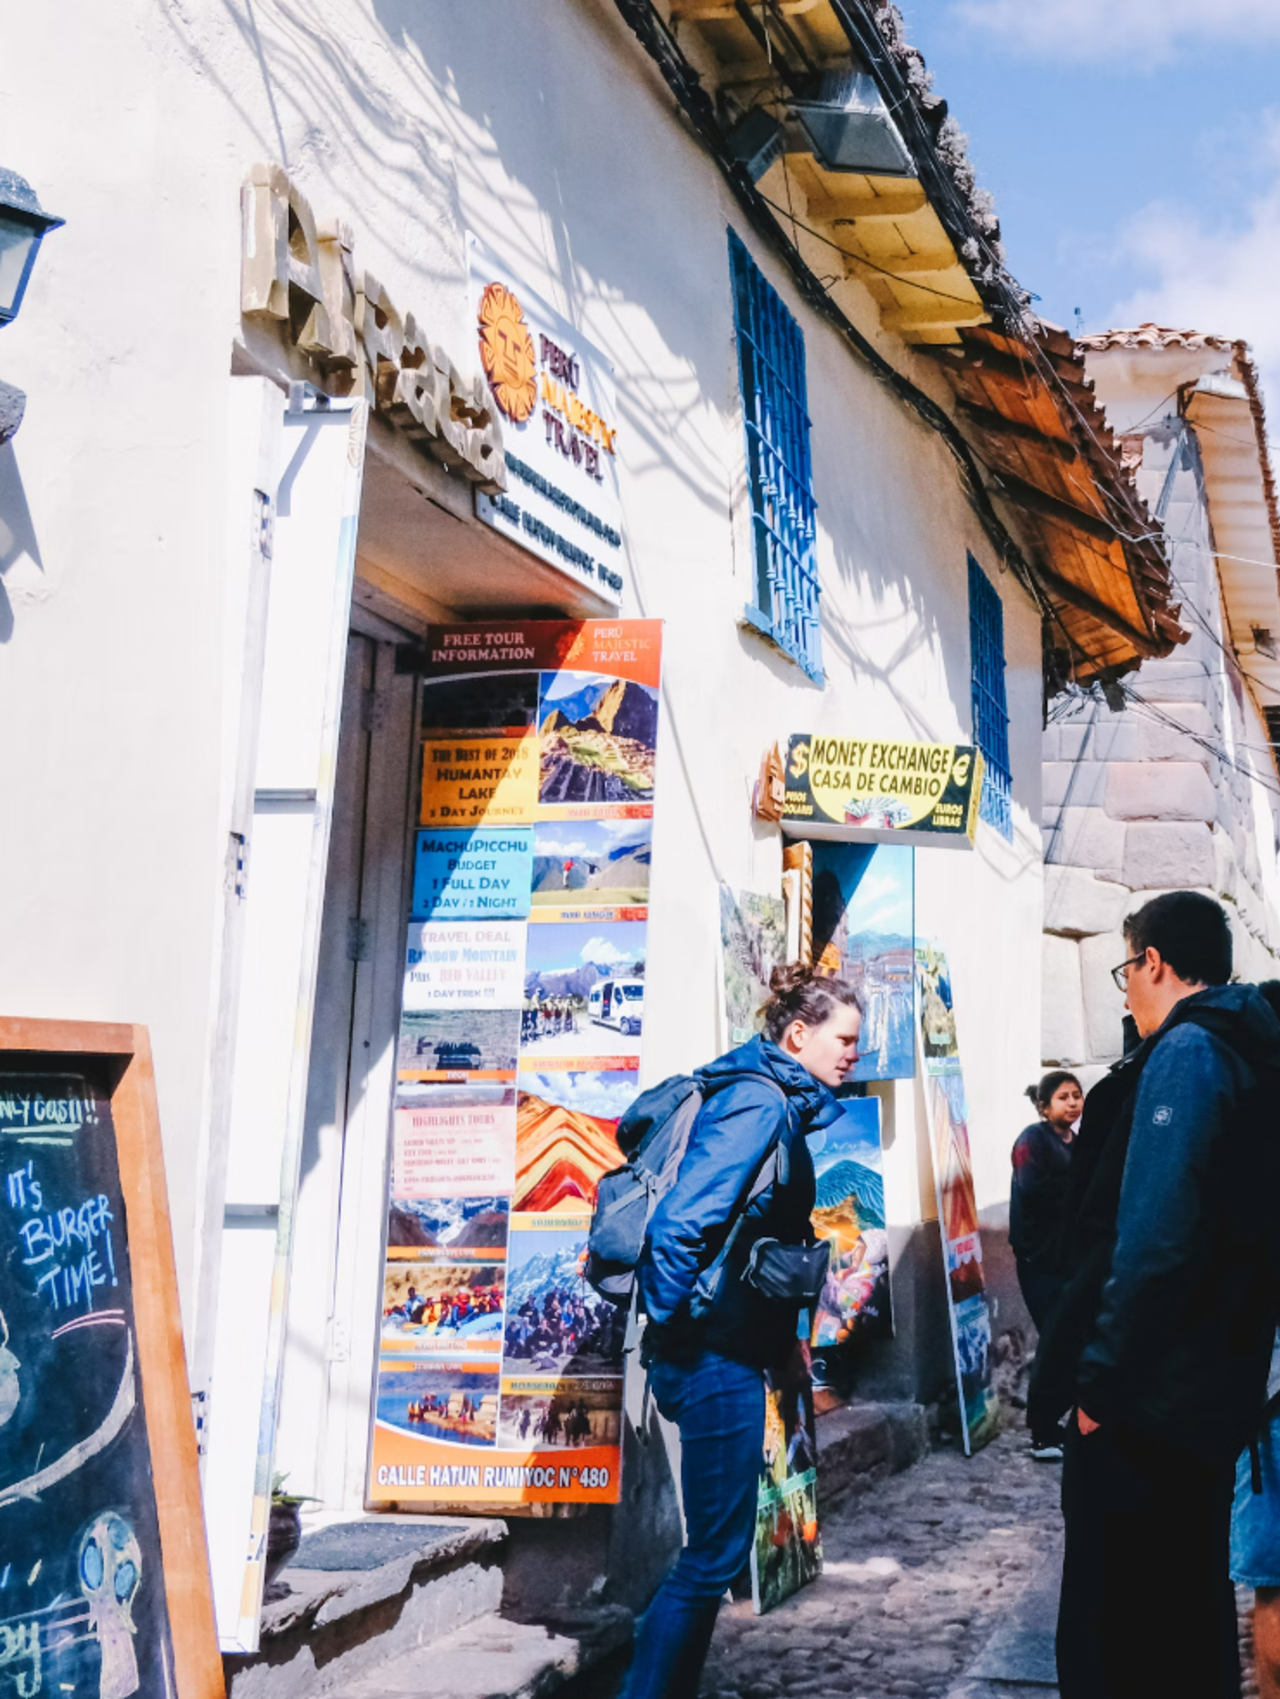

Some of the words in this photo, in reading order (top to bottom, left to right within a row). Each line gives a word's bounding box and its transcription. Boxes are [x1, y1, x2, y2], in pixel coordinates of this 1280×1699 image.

[542, 409, 604, 481] TRAVEL
[443, 633, 481, 647] FREE
[484, 632, 525, 645] TOUR
[593, 627, 623, 640] PERÚ
[593, 639, 651, 650] MAJESTIC
[431, 647, 535, 662] INFORMATION
[592, 650, 637, 662] TRAVEL
[455, 748, 480, 762] BEST
[485, 748, 497, 761] OF
[811, 739, 868, 767] MONEY
[869, 743, 950, 774] EXCHANGE
[436, 768, 522, 781] HUMANTAY
[812, 769, 851, 790] CASA
[857, 772, 876, 792] DE
[879, 774, 941, 797] CAMBIO
[458, 787, 497, 799] LAKE
[440, 806, 467, 817] DAY
[470, 805, 525, 817] JOURNEY
[934, 803, 963, 815] EUROS
[932, 815, 961, 828] LIBRAS
[421, 839, 528, 853] MACHUPICCHU
[447, 859, 497, 871] BUDGET
[442, 877, 475, 890] FULL
[479, 877, 510, 889] DAY
[432, 896, 459, 908] DAY
[477, 896, 517, 908] NIGHT
[421, 931, 470, 943] TRAVEL
[475, 930, 511, 942] DEAL
[461, 948, 517, 963] MOUNTAIN
[433, 990, 455, 998] DAY
[457, 989, 481, 998] TREK
[0, 1090, 30, 1126] NLY
[20, 1194, 114, 1263] BURGER
[37, 1230, 118, 1311] TIME!
[377, 1464, 426, 1487] CALLE
[429, 1465, 480, 1488] HATUN
[483, 1466, 555, 1488] RUMIYOC
